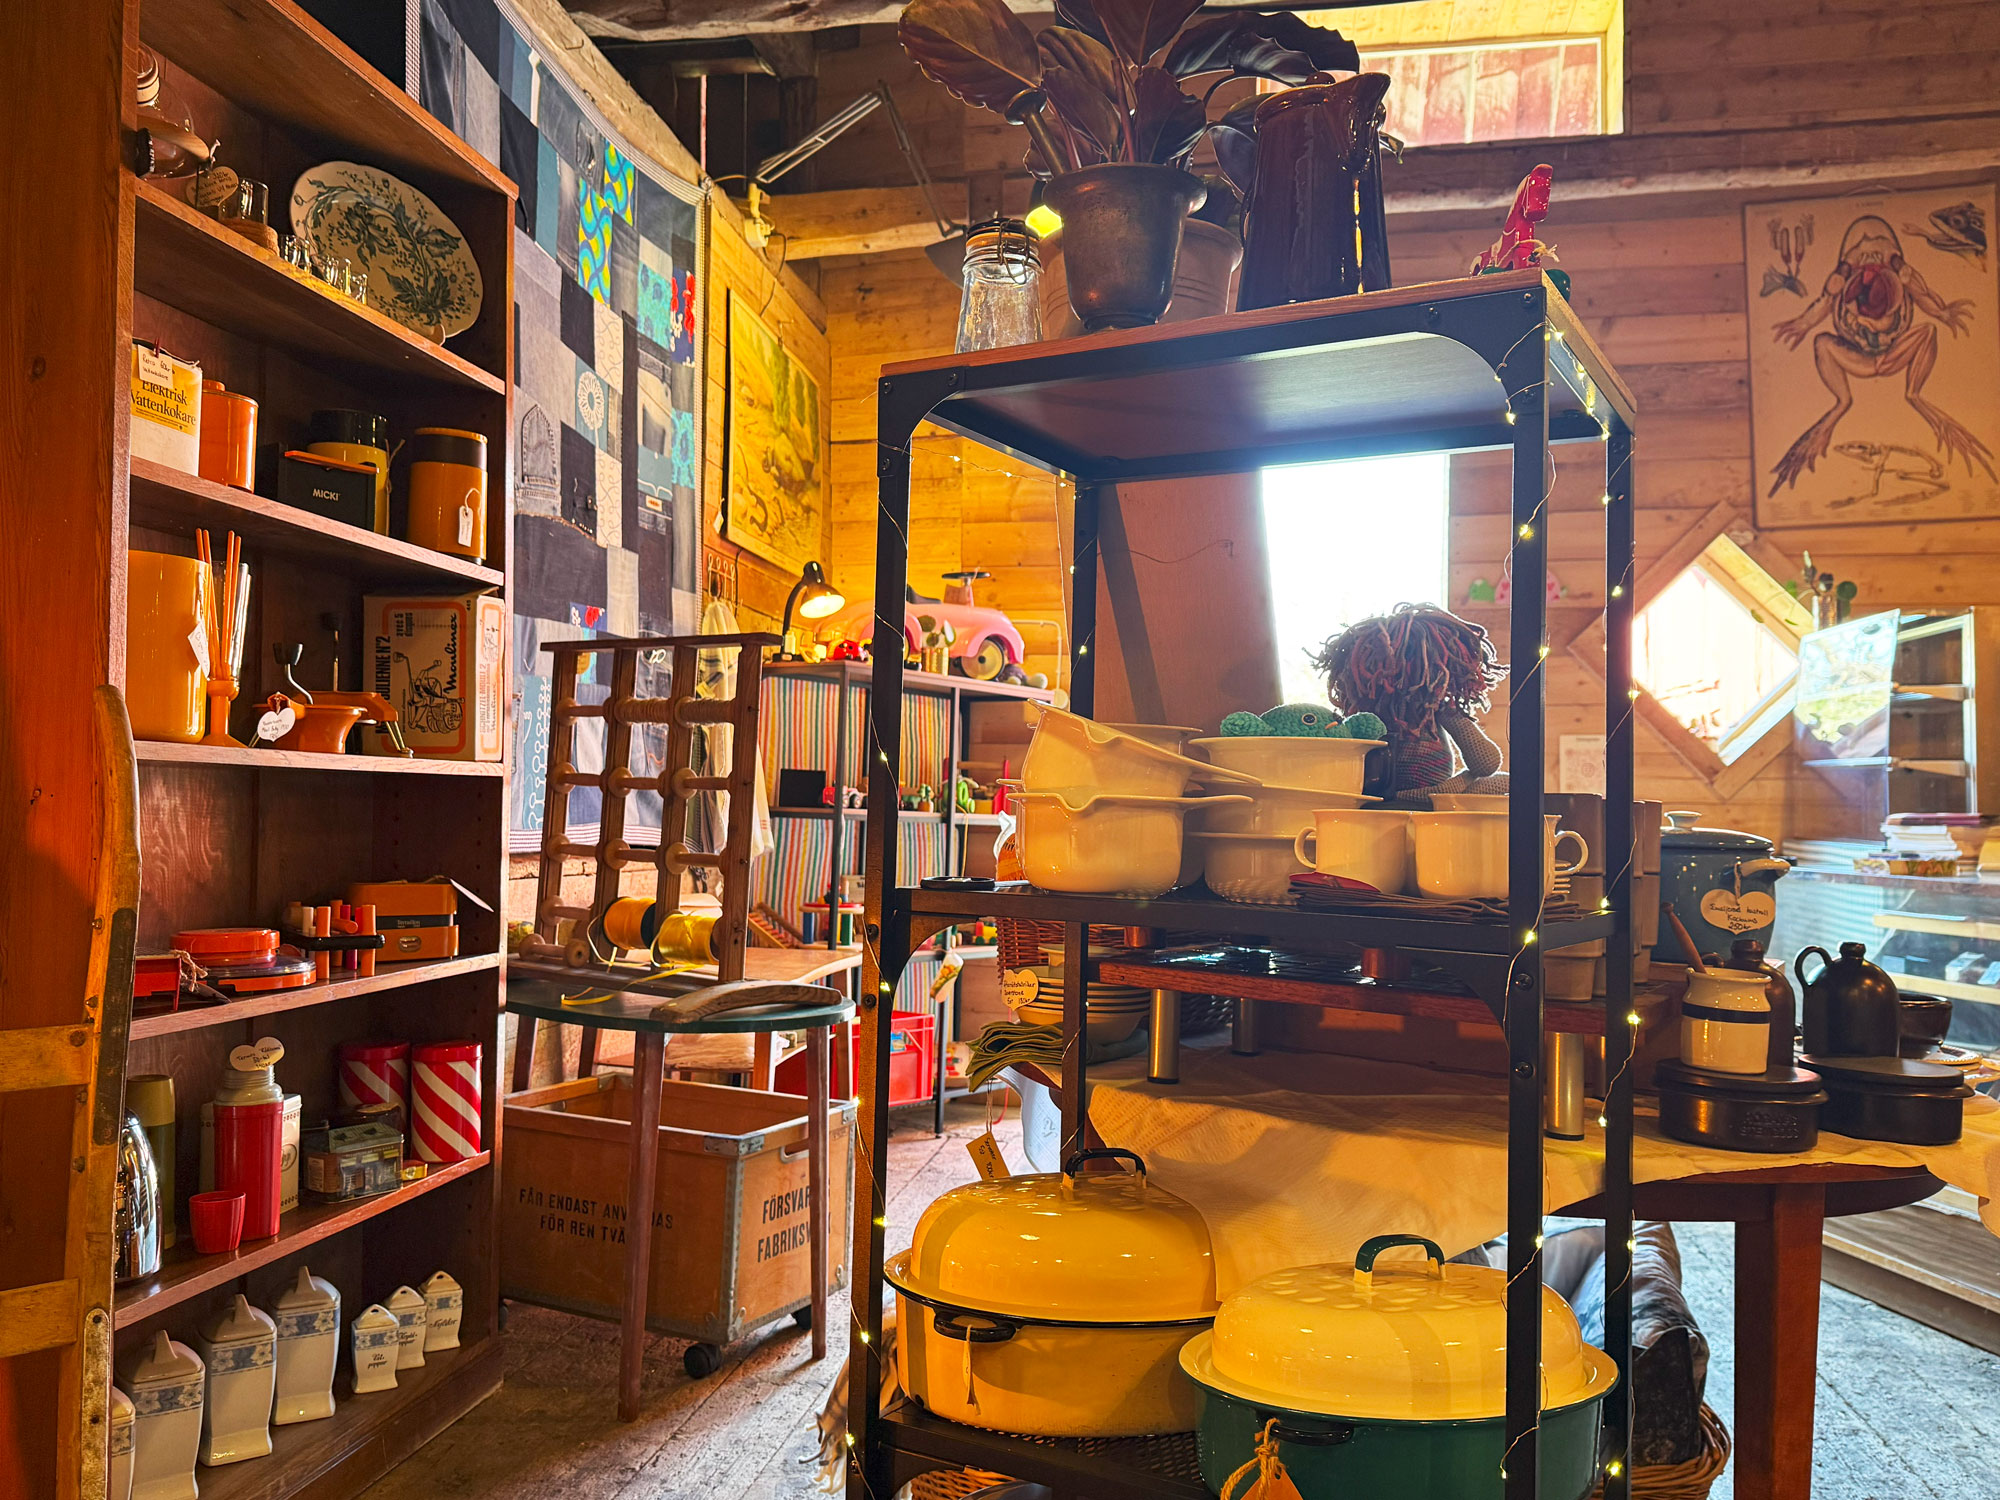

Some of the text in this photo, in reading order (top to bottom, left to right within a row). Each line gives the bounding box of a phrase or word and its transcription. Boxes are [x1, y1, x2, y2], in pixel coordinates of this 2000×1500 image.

[131, 389, 196, 425] Vattenkokare
[312, 488, 339, 501] MICKI
[444, 613, 457, 694] Moulinex
[519, 1187, 674, 1230] FÅR ENDAST ANVAS
[762, 1185, 811, 1225] FÖRSVAR
[540, 1215, 627, 1244] FÖR REN TVÄ
